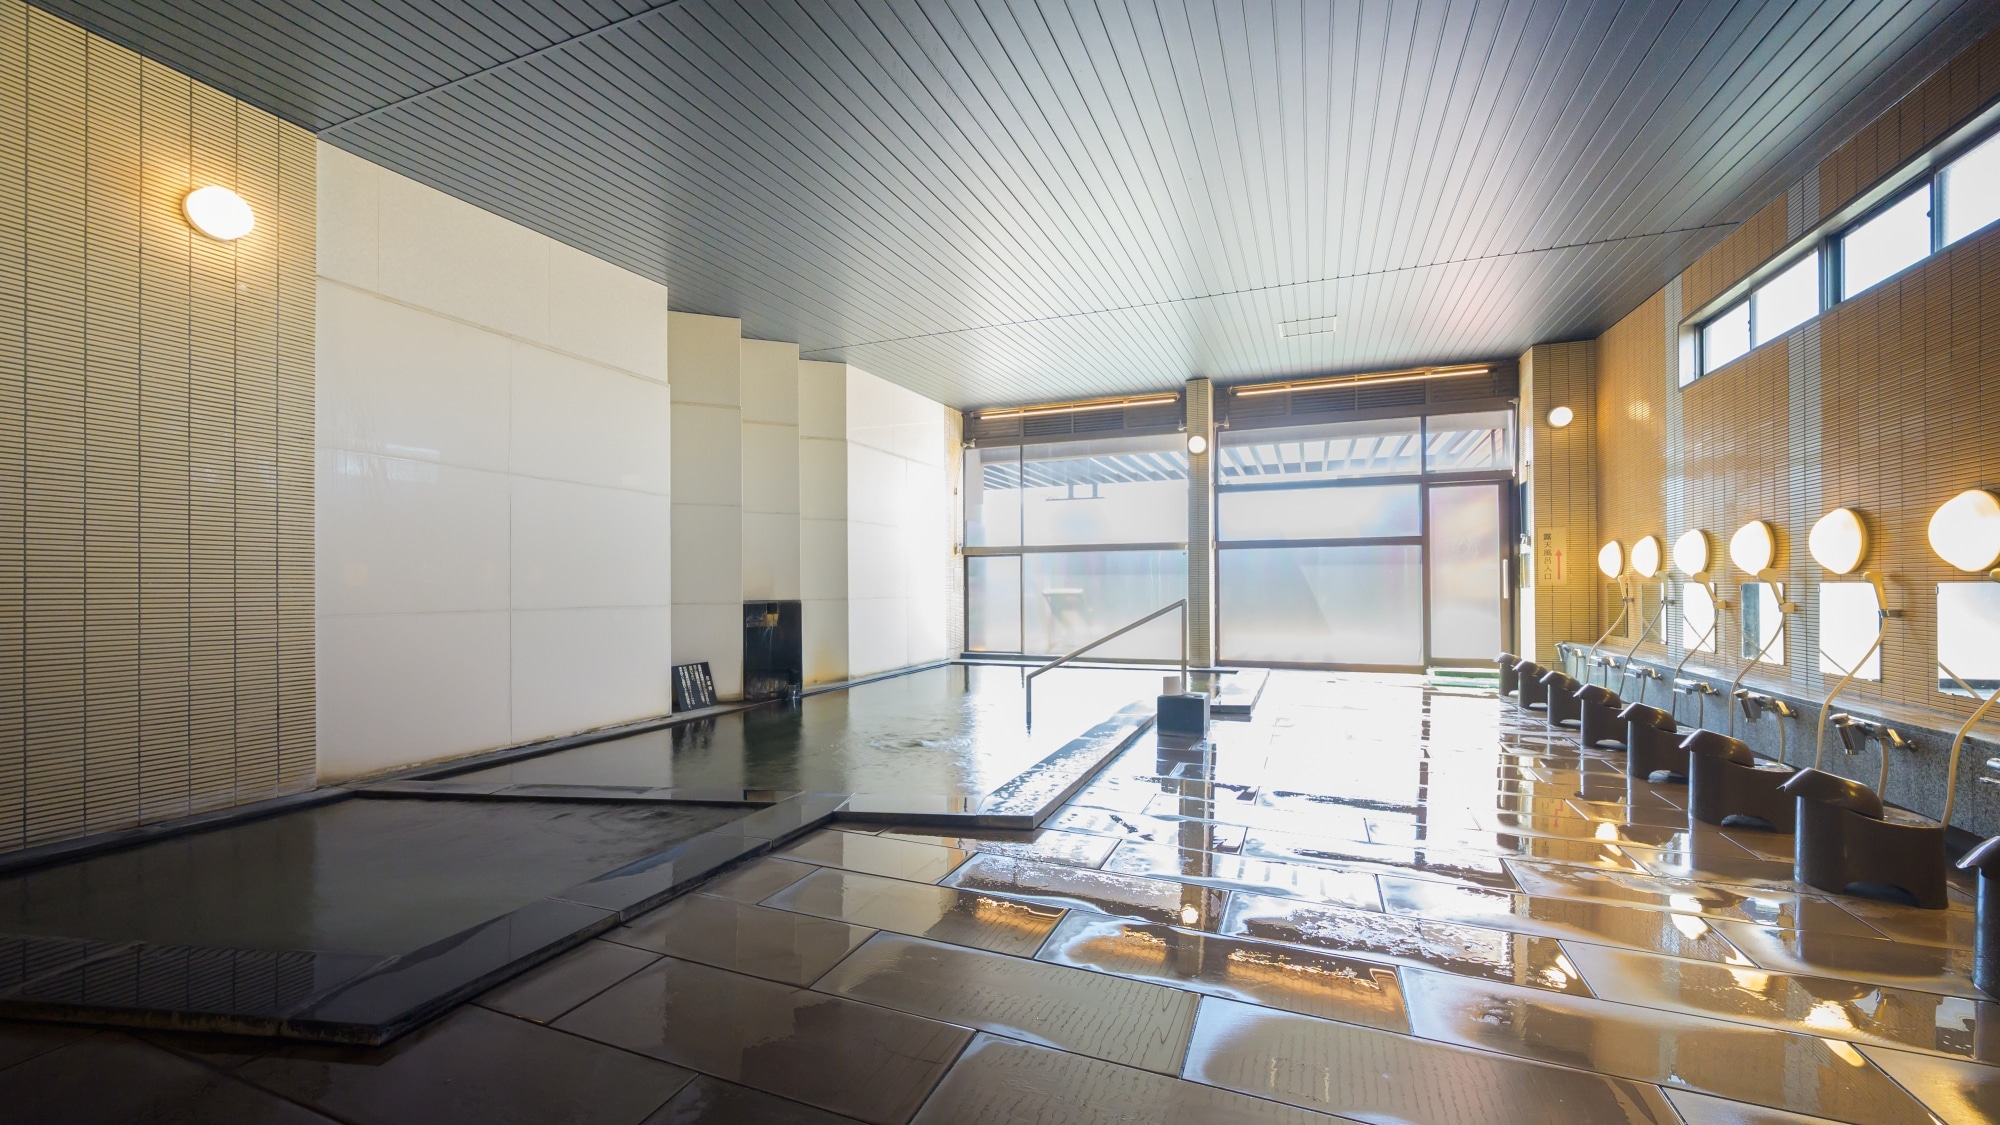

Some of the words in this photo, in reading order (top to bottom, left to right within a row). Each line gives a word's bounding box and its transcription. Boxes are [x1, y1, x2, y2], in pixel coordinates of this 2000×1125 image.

[1543, 533, 1552, 580] 露天風呂入口
